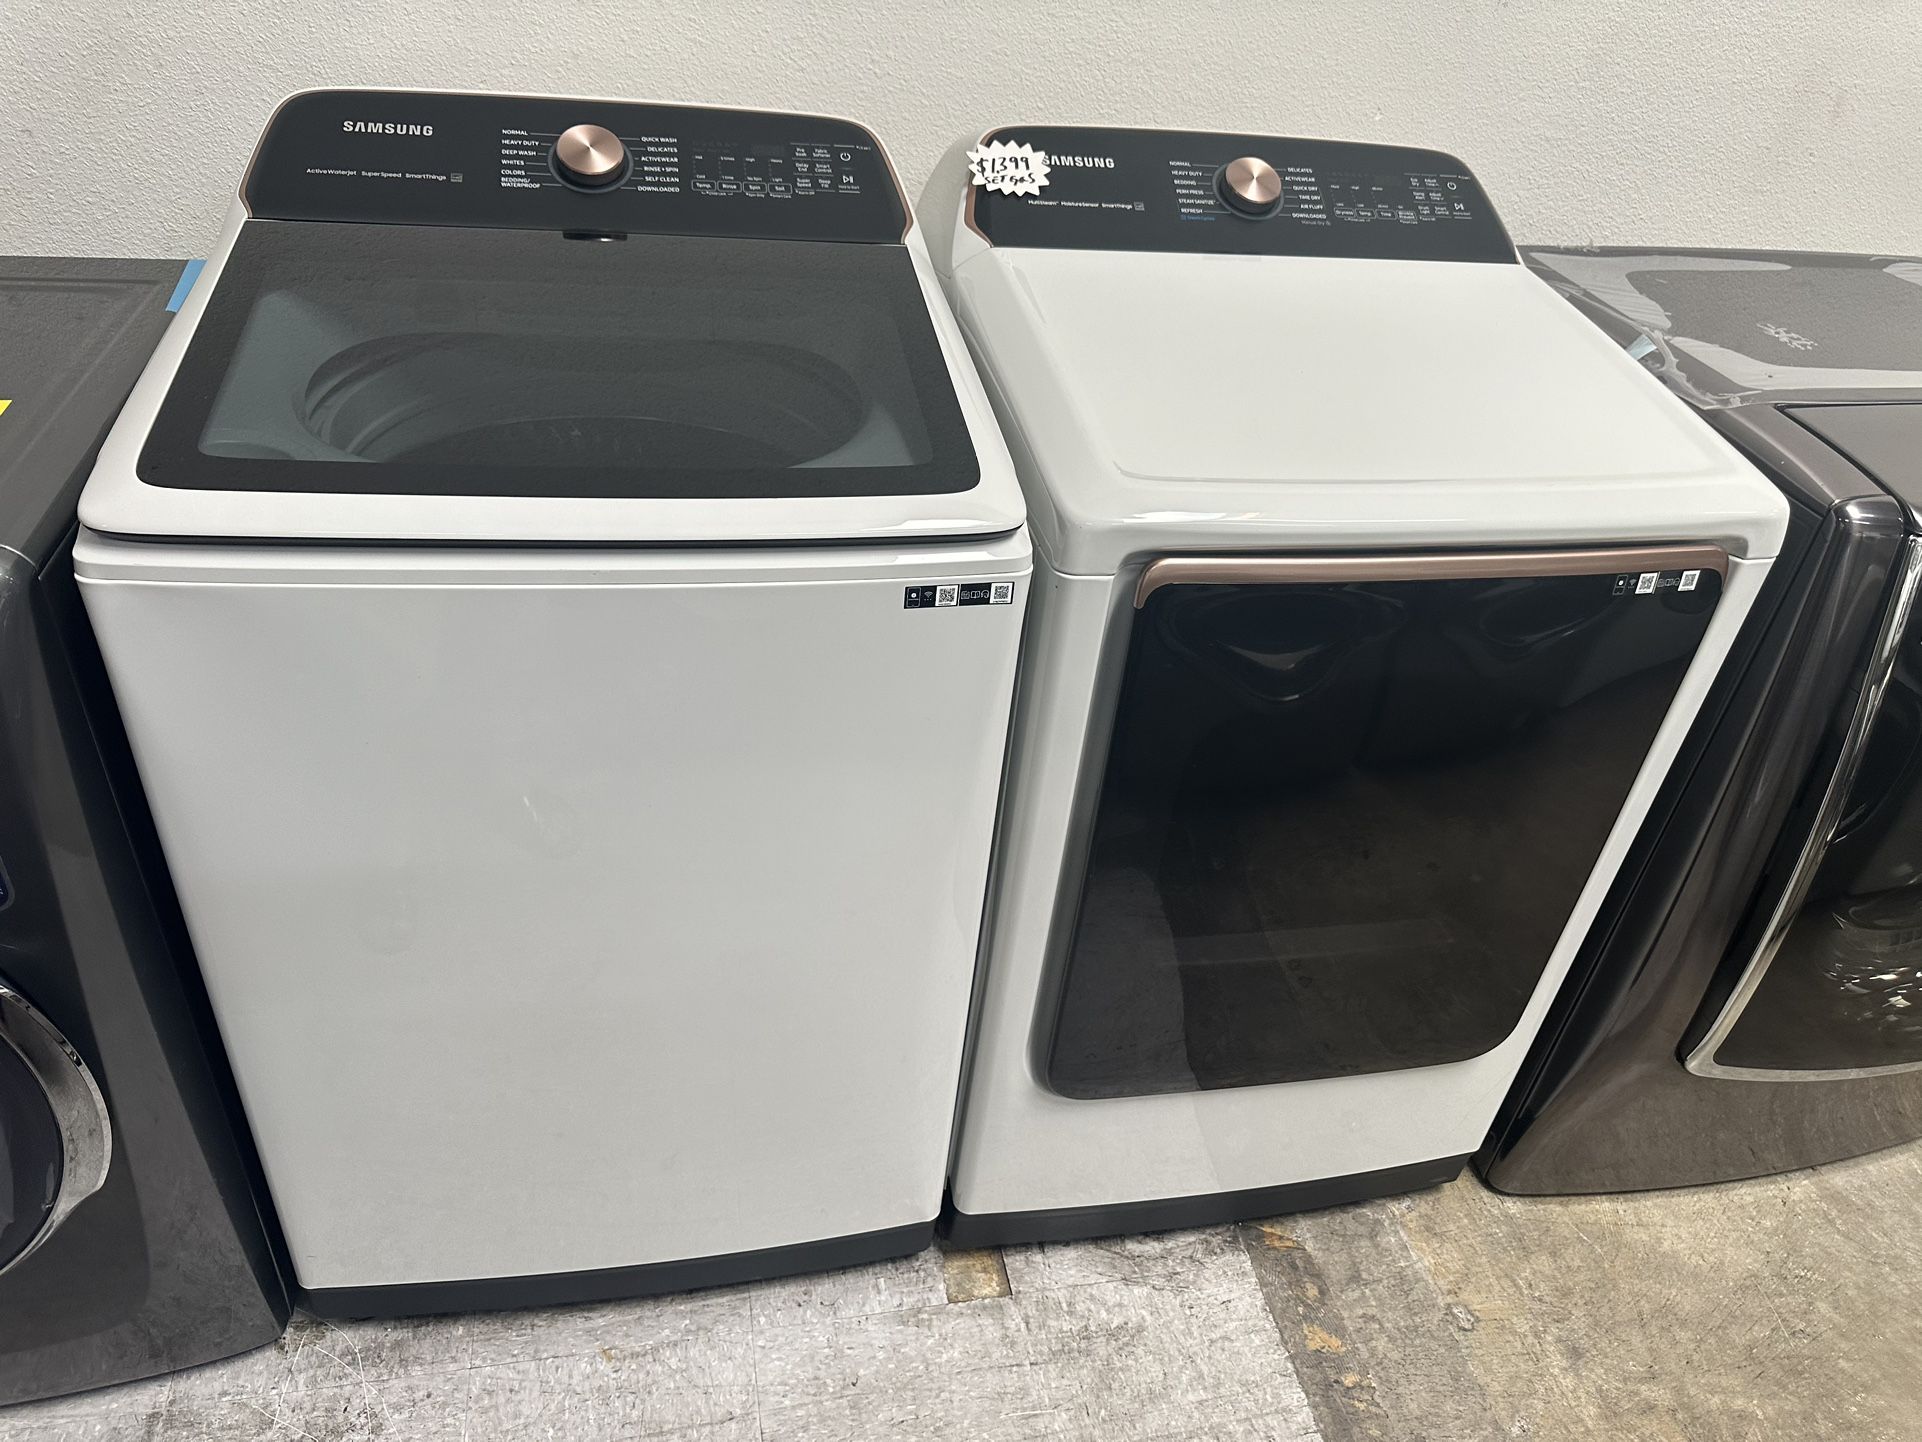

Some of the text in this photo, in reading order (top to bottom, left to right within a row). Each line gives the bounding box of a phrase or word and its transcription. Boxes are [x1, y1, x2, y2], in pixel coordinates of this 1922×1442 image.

[342, 120, 434, 136] SAMSUNG
[1042, 154, 1115, 168] SAMSUNG
[405, 173, 447, 181] SmartThings
[984, 174, 1008, 184] SET
